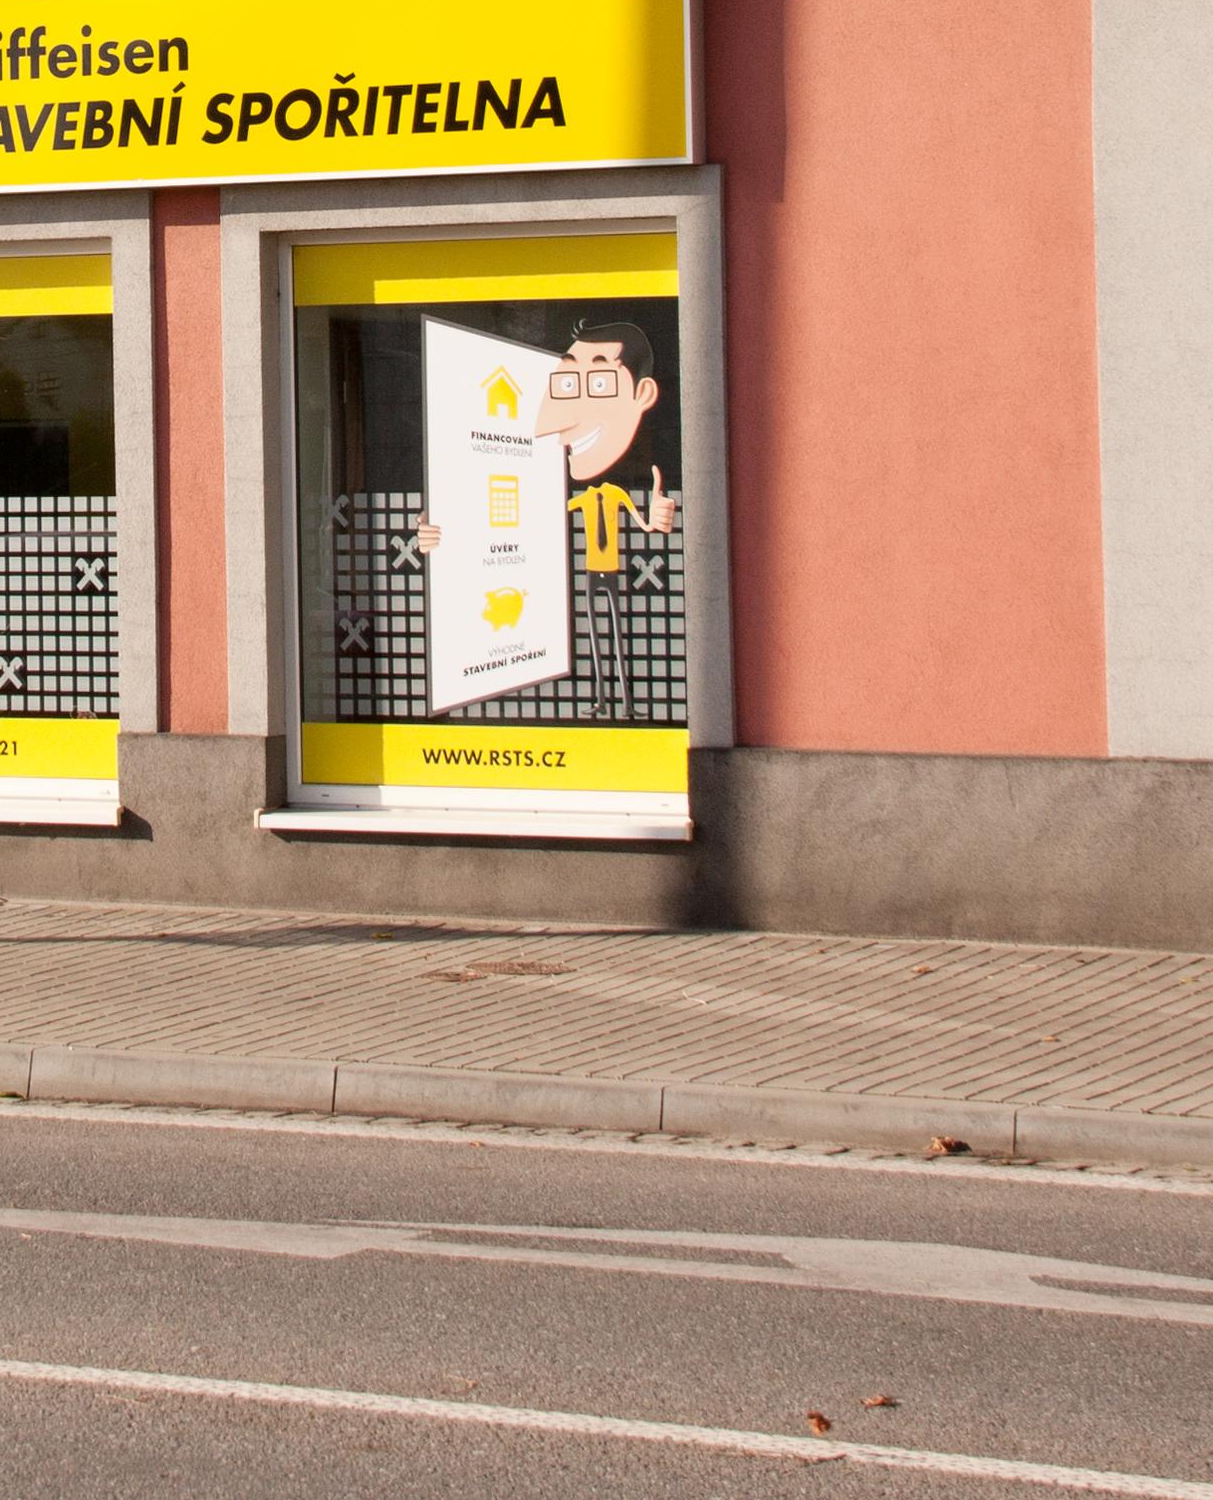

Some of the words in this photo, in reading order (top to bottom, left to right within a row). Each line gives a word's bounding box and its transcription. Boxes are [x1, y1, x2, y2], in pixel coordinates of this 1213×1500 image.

[201, 72, 568, 145] SPOŘITELNA
[471, 431, 533, 446] FINANCOVÁNÍ
[490, 543, 519, 553] ÚVĚRY
[483, 557, 496, 567] NA
[463, 659, 507, 677] STAVEBNÍ
[510, 649, 547, 665] SPOŘENÍ
[422, 748, 566, 767] WWW.RSTS.CZ
